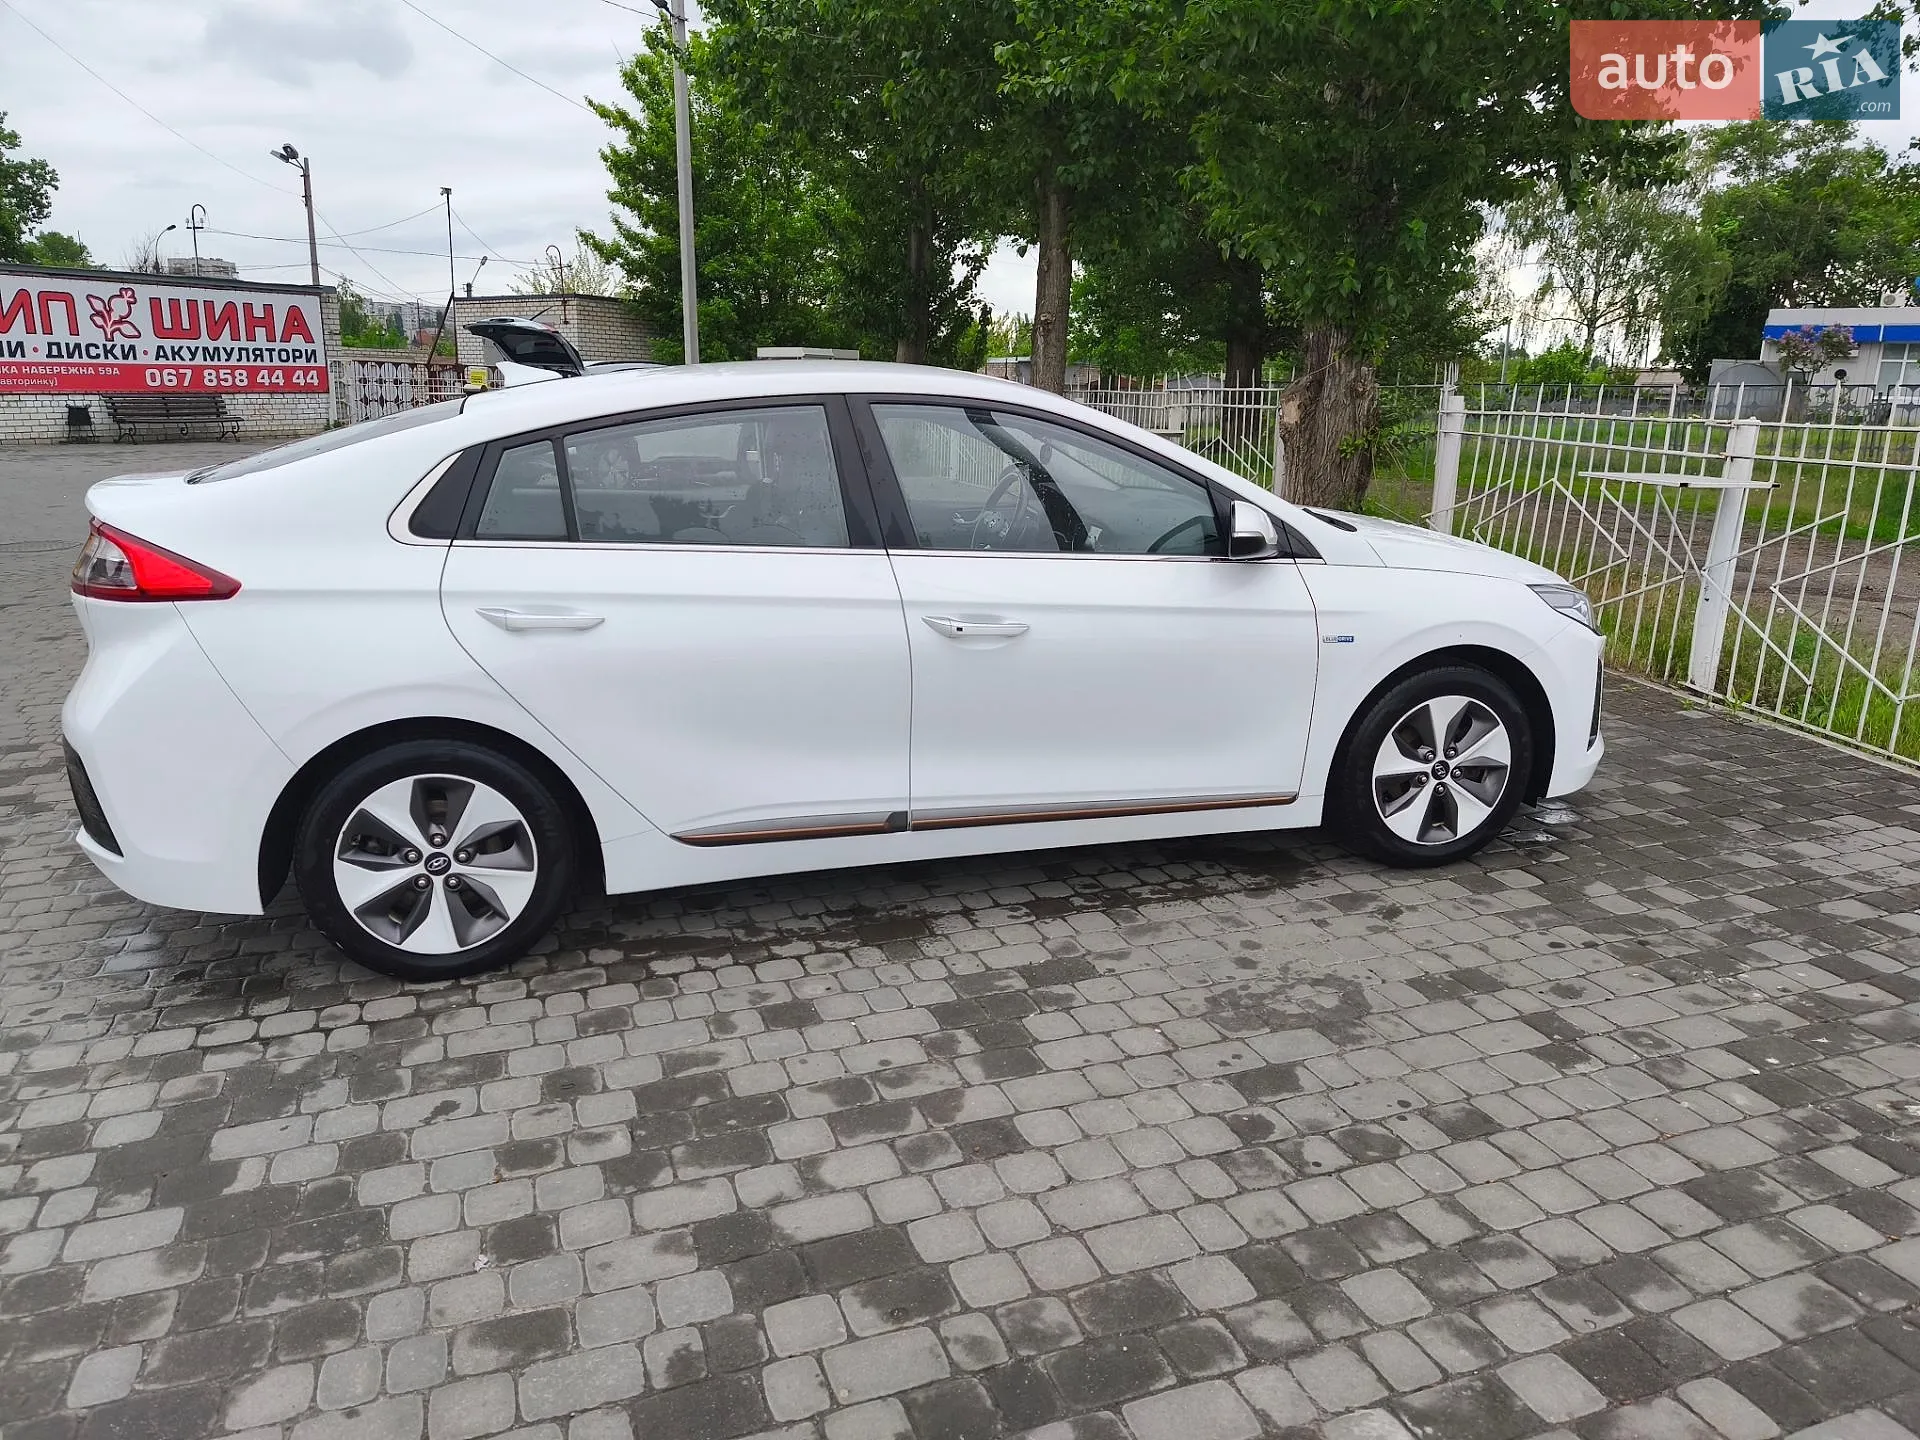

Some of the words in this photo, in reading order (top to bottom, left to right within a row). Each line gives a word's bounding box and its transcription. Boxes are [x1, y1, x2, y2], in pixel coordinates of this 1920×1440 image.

[149, 297, 315, 344] ШИНА
[0, 340, 26, 359] И
[45, 341, 138, 361] ДИСКИ
[154, 345, 318, 364] АКУМУЛЯТОРИ
[0, 365, 18, 375] КА
[22, 365, 95, 375] НАБЕРЕЖНА
[98, 367, 121, 376] 59А
[145, 368, 192, 387] 067
[203, 369, 249, 387] 858
[256, 369, 285, 386] 44
[292, 370, 319, 386] 44
[0, 377, 58, 387] авторинку)
